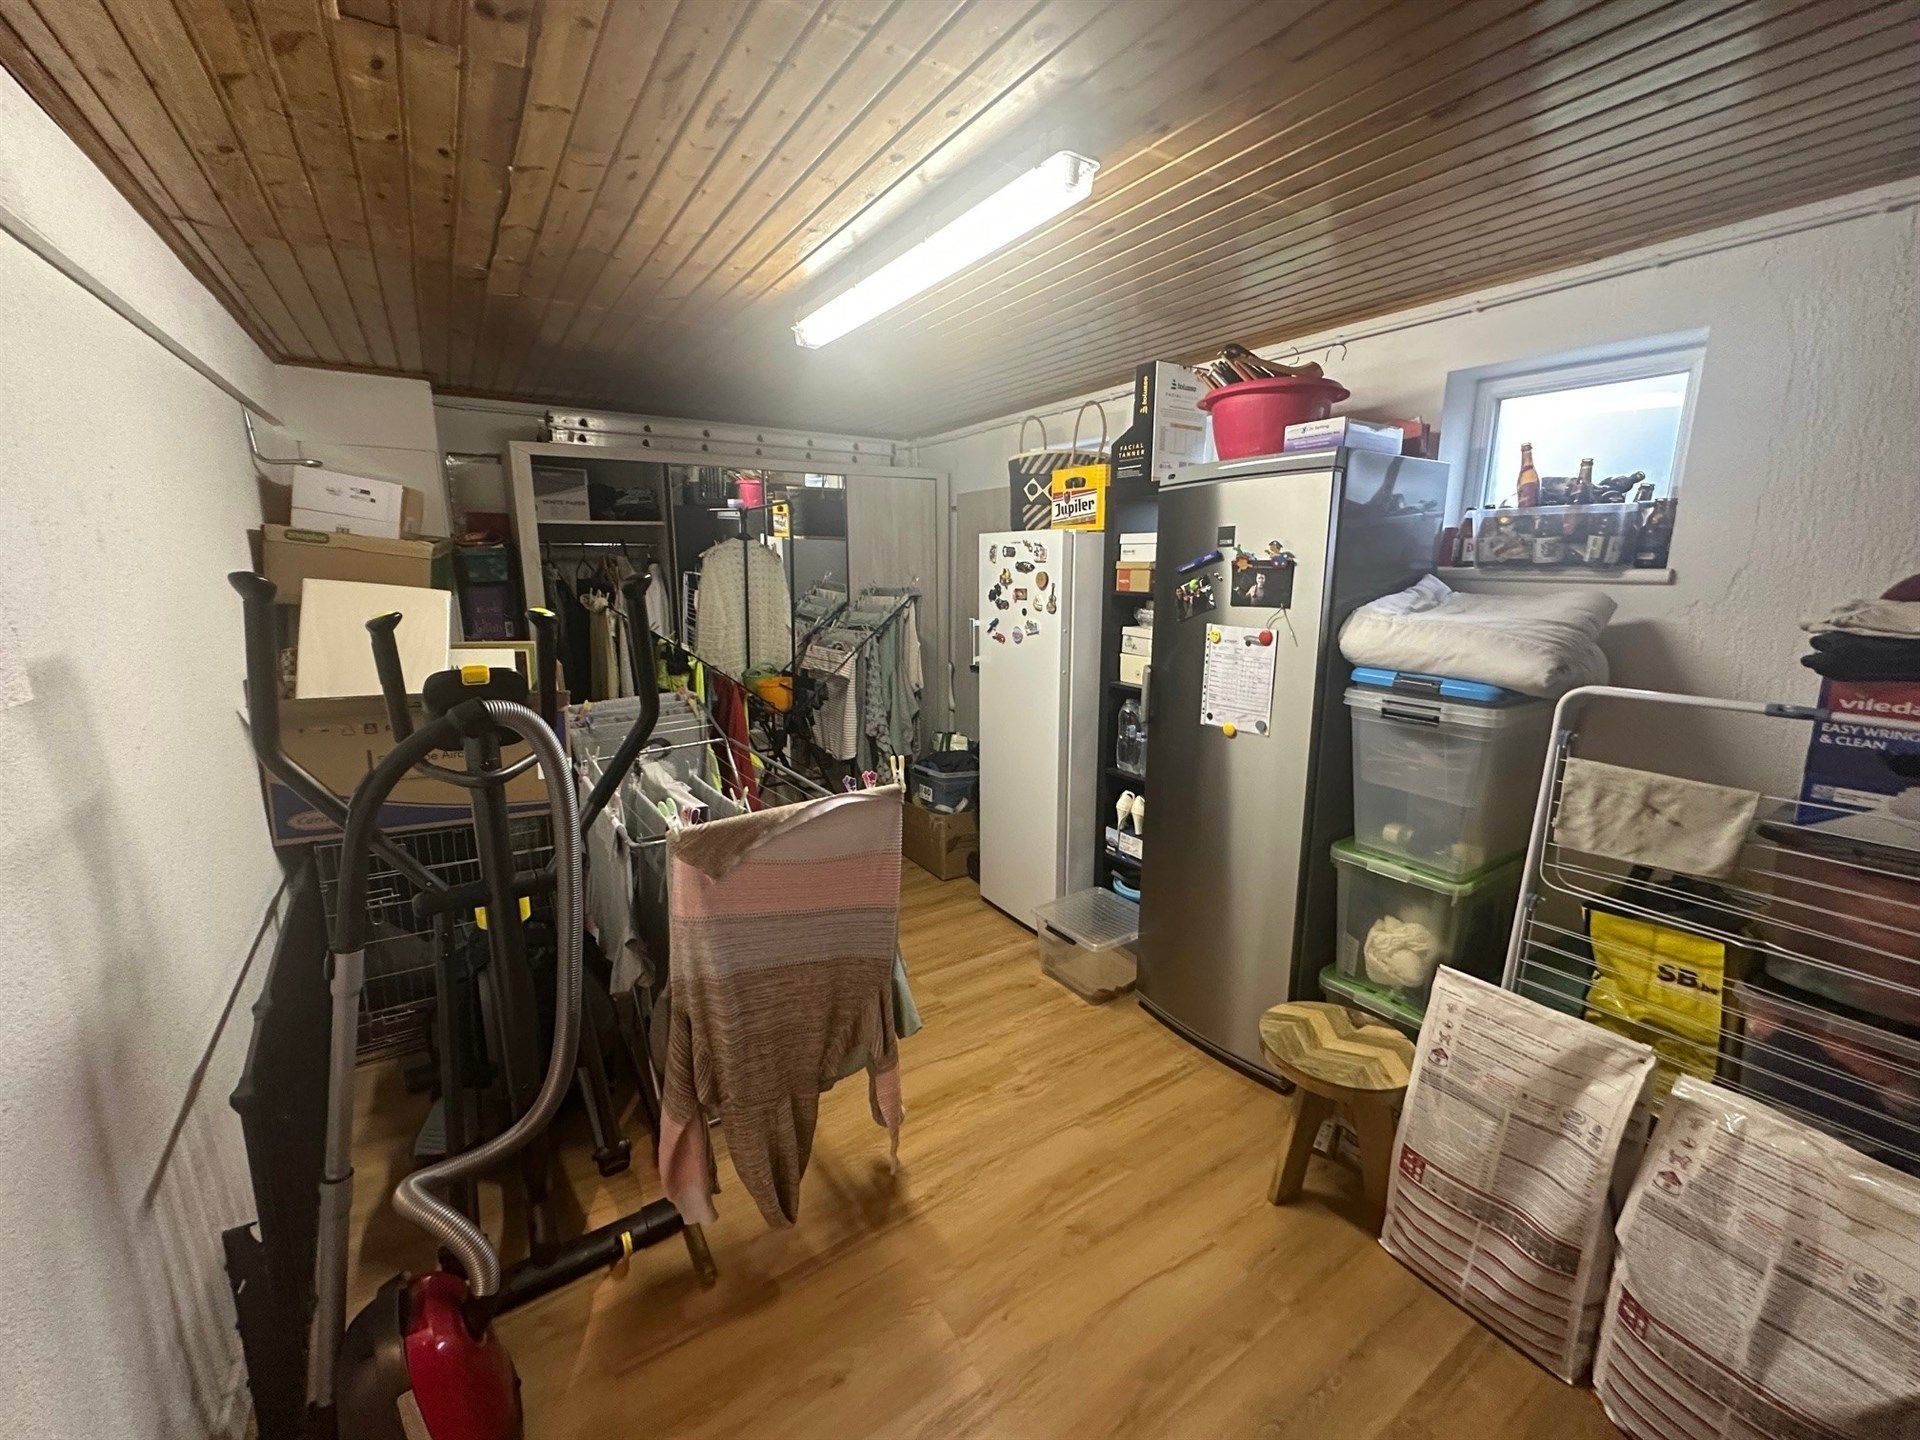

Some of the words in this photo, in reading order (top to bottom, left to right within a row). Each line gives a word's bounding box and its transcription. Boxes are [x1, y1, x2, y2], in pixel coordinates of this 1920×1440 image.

[1120, 442, 1144, 451] FACIAL
[1118, 449, 1145, 458] TANNER
[1055, 499, 1095, 517] Jupiler
[1821, 722, 1860, 734] EASY
[1820, 734, 1832, 744] &
[1835, 736, 1887, 750] CLEAN
